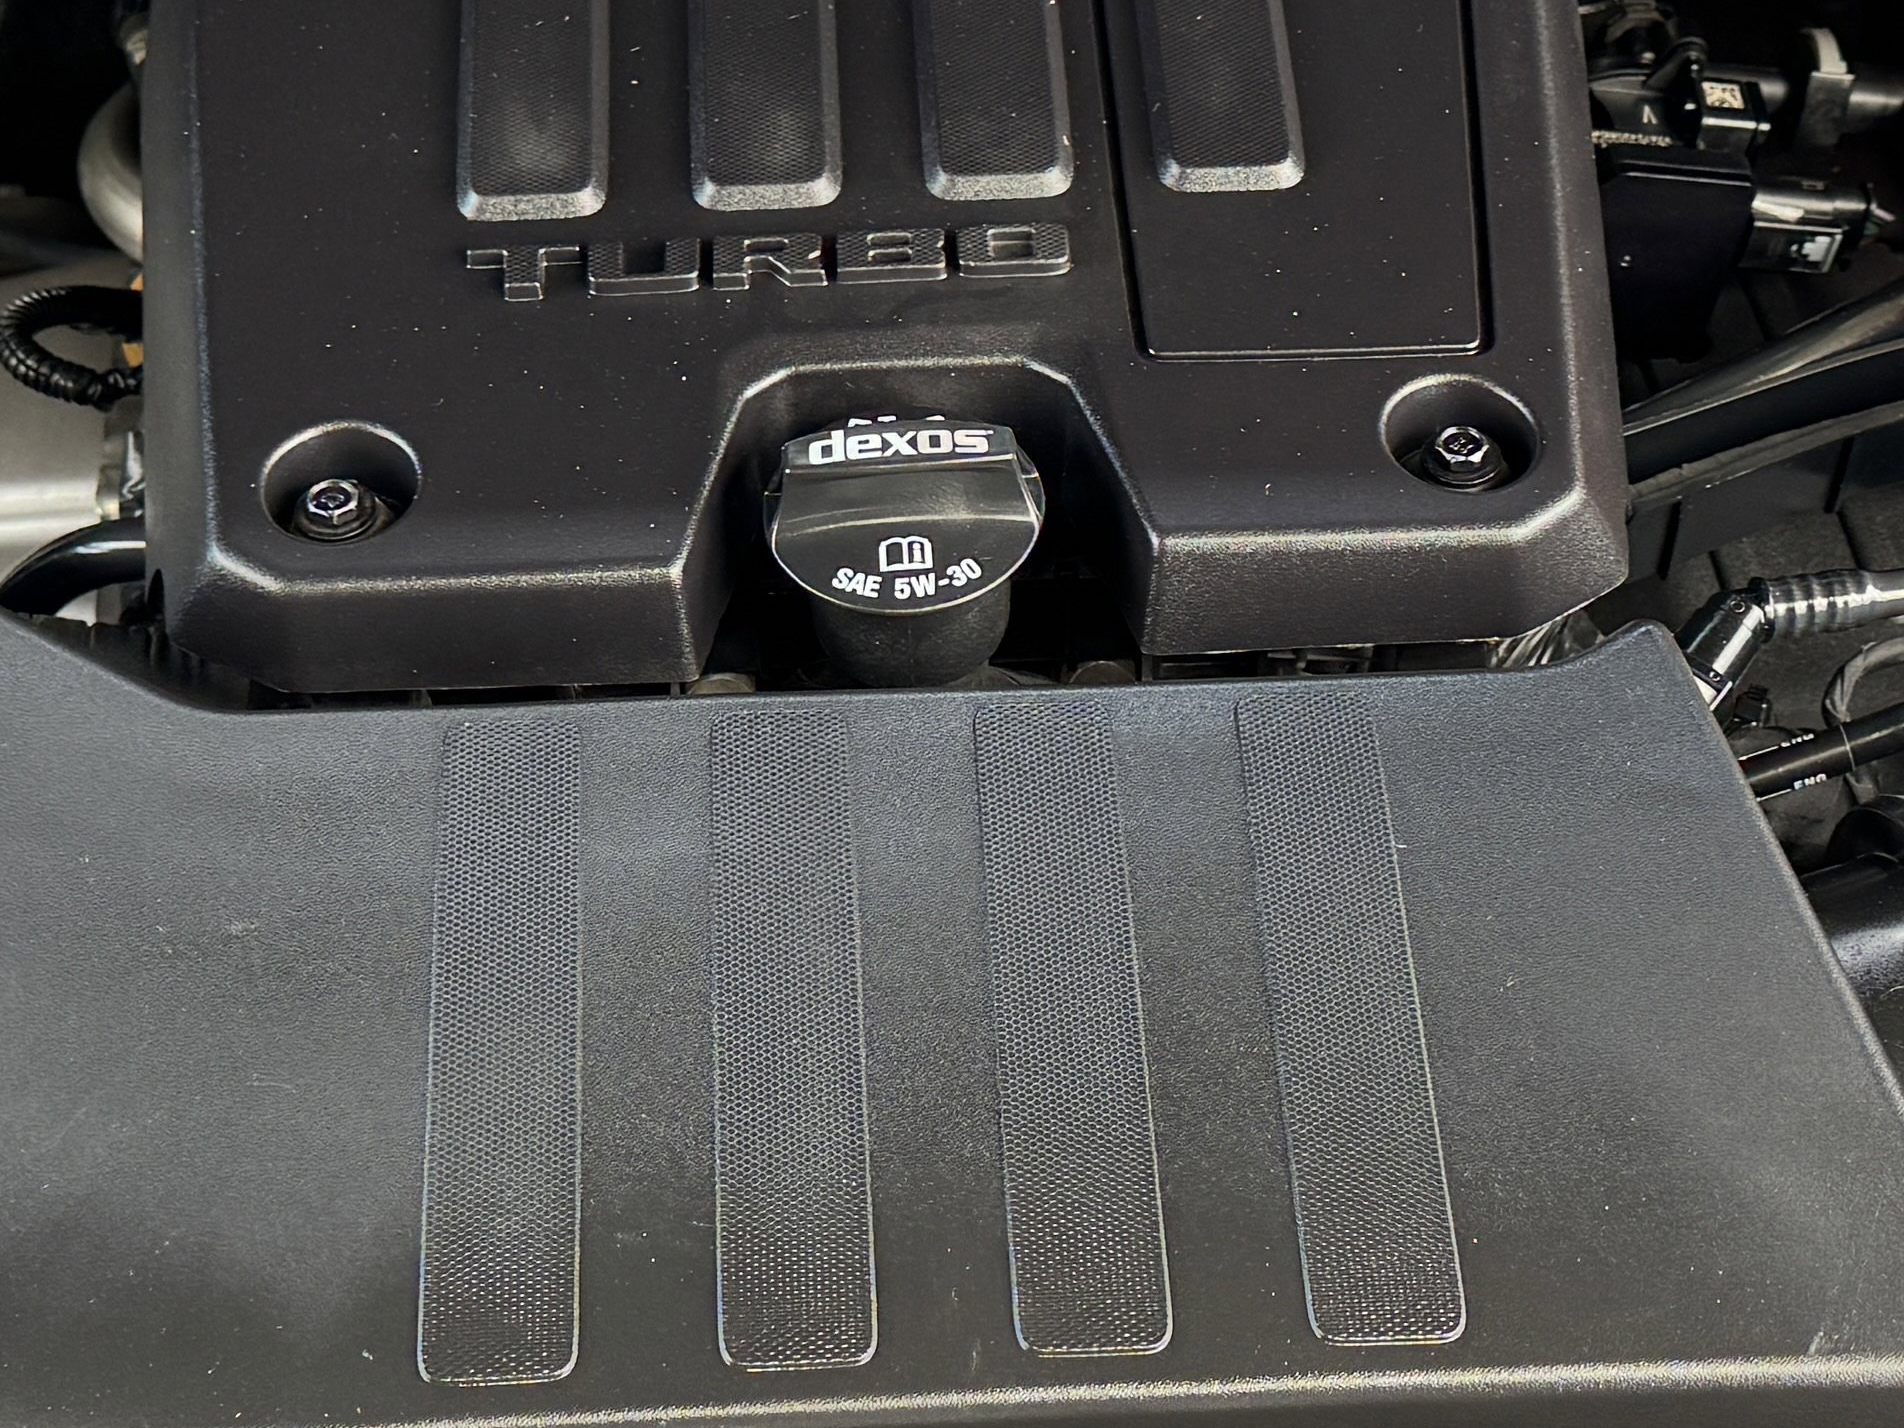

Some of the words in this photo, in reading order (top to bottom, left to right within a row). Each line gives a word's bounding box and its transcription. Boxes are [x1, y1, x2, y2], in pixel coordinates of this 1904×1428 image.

[465, 224, 1073, 302] TURBO
[808, 429, 989, 466] dexos
[831, 568, 882, 598] SAE
[894, 558, 982, 600] 5W-30
